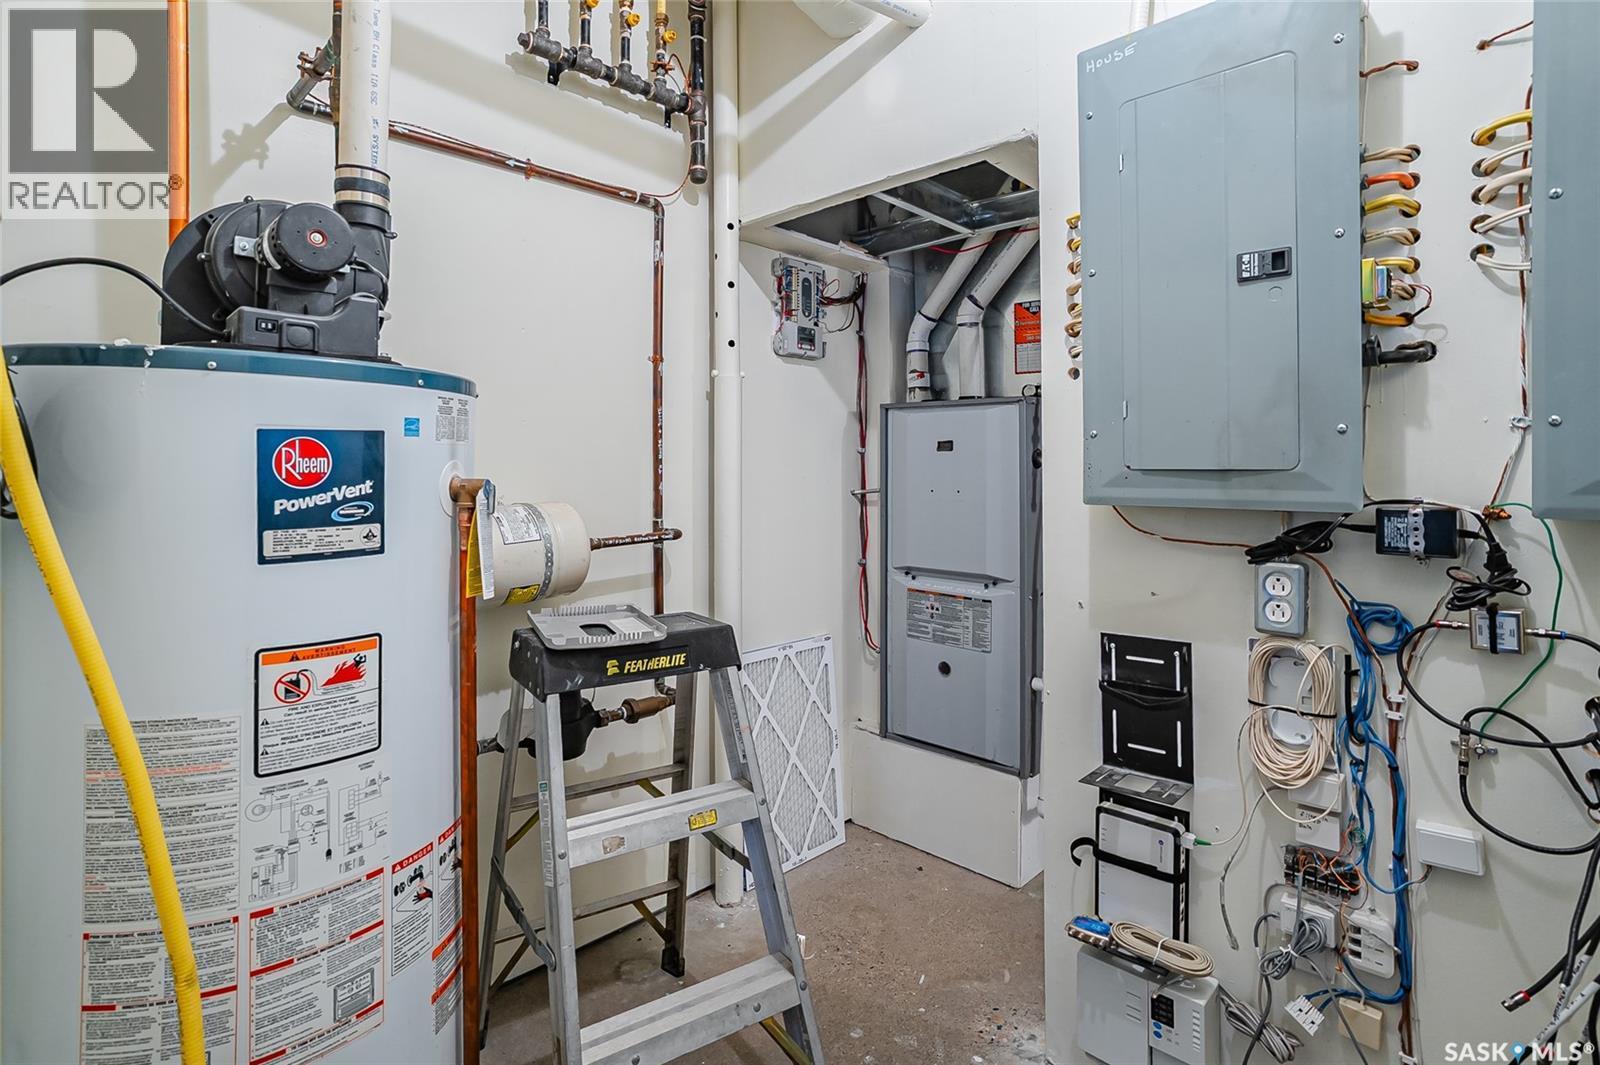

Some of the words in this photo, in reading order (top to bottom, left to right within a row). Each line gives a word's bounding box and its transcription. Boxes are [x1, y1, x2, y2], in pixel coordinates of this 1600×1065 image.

[1086, 41, 1137, 72] HOUSE
[281, 439, 328, 480] Rheem
[273, 480, 374, 515] PowerVent
[623, 653, 687, 674] FEATHERLITE
[402, 845, 433, 866] DANGER
